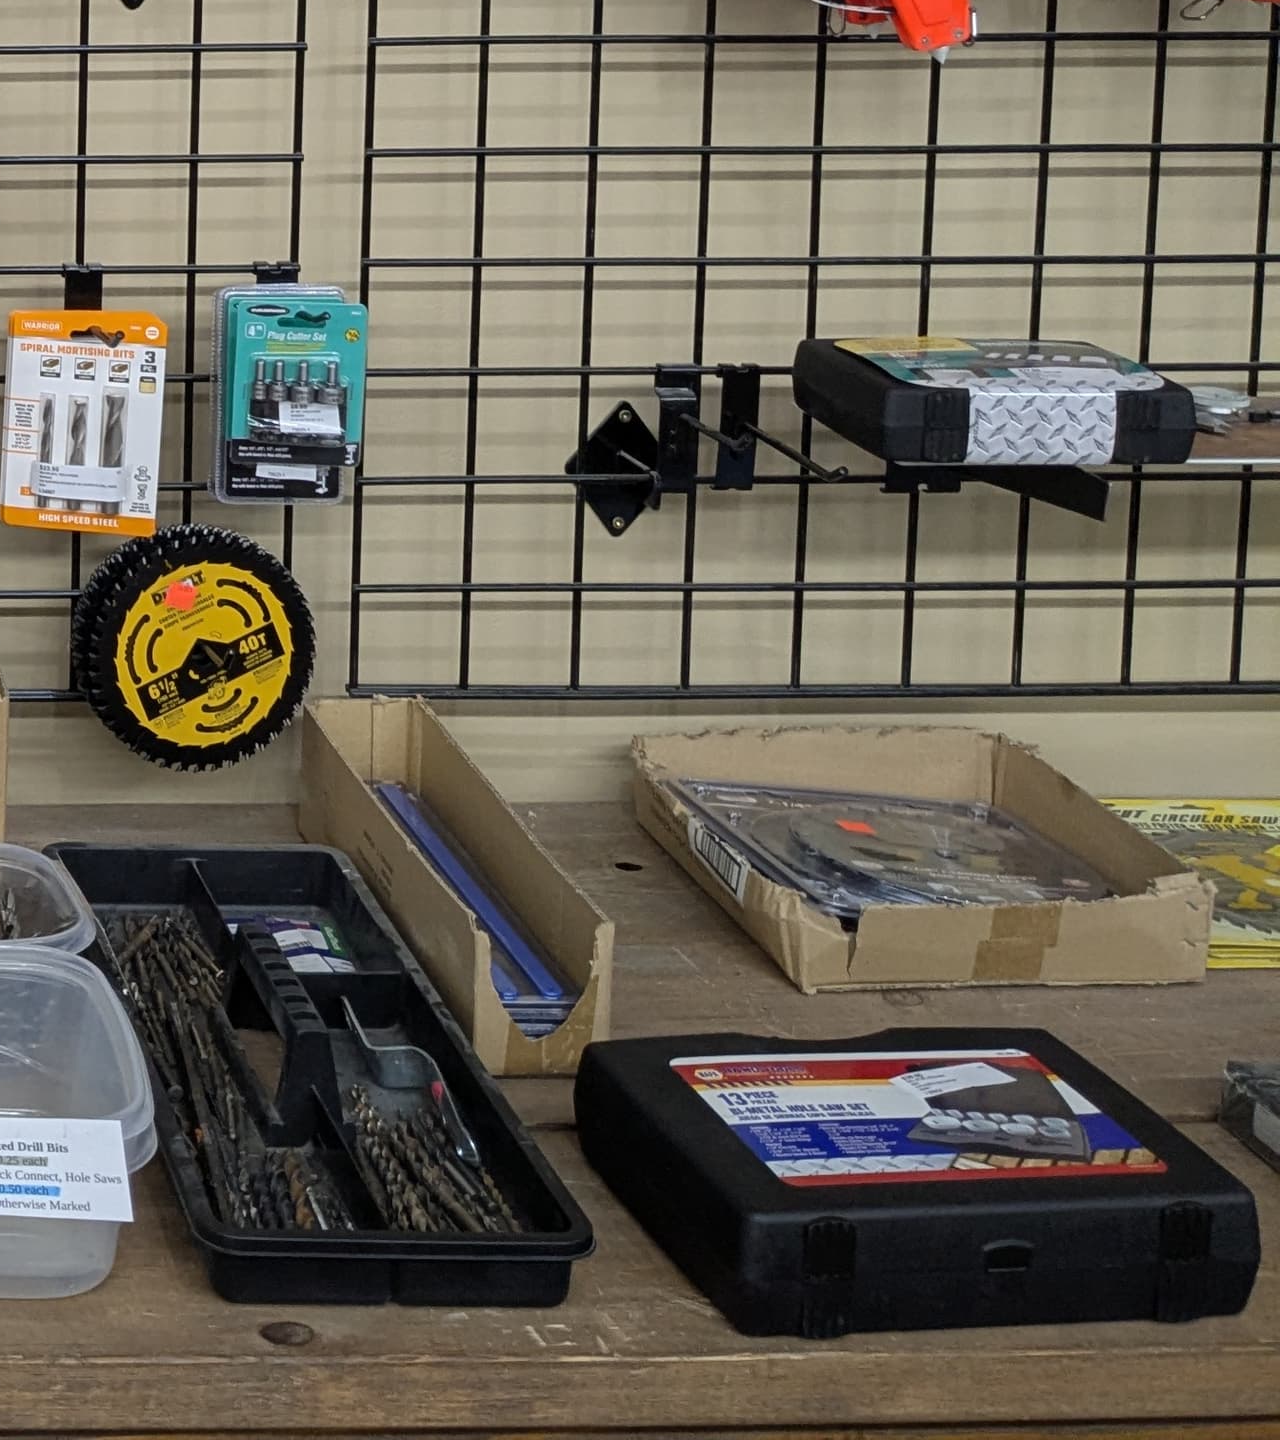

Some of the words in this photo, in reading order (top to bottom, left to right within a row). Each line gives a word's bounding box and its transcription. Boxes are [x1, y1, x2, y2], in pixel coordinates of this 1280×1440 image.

[23, 321, 61, 330] WARRIOR
[268, 331, 286, 342] Plug
[288, 331, 311, 340] Cutter
[313, 332, 327, 341] Set
[20, 343, 55, 353] SPIRAL
[57, 345, 112, 356] MORTISING
[114, 348, 135, 359] BITS
[144, 351, 156, 364] 3
[39, 513, 60, 523] HIGH
[63, 515, 90, 525] SPEED
[92, 517, 119, 527] STEEL
[1150, 813, 1235, 823] CIRCULAR
[1239, 815, 1278, 825] SAW
[717, 1092, 747, 1106] 13
[744, 1091, 779, 1099] PIECE
[728, 1106, 786, 1116] BI-METAL
[786, 1104, 817, 1113] HOLE
[819, 1104, 846, 1113] SAW
[847, 1103, 871, 1111] SET
[17, 1141, 44, 1153] Drill
[47, 1142, 69, 1154] Bits
[22, 1157, 48, 1166] each
[14, 1170, 62, 1183] Connect,
[65, 1172, 90, 1184] Hole
[94, 1173, 122, 1185] Saws
[24, 1185, 49, 1195] each
[49, 1200, 91, 1212] Marked
